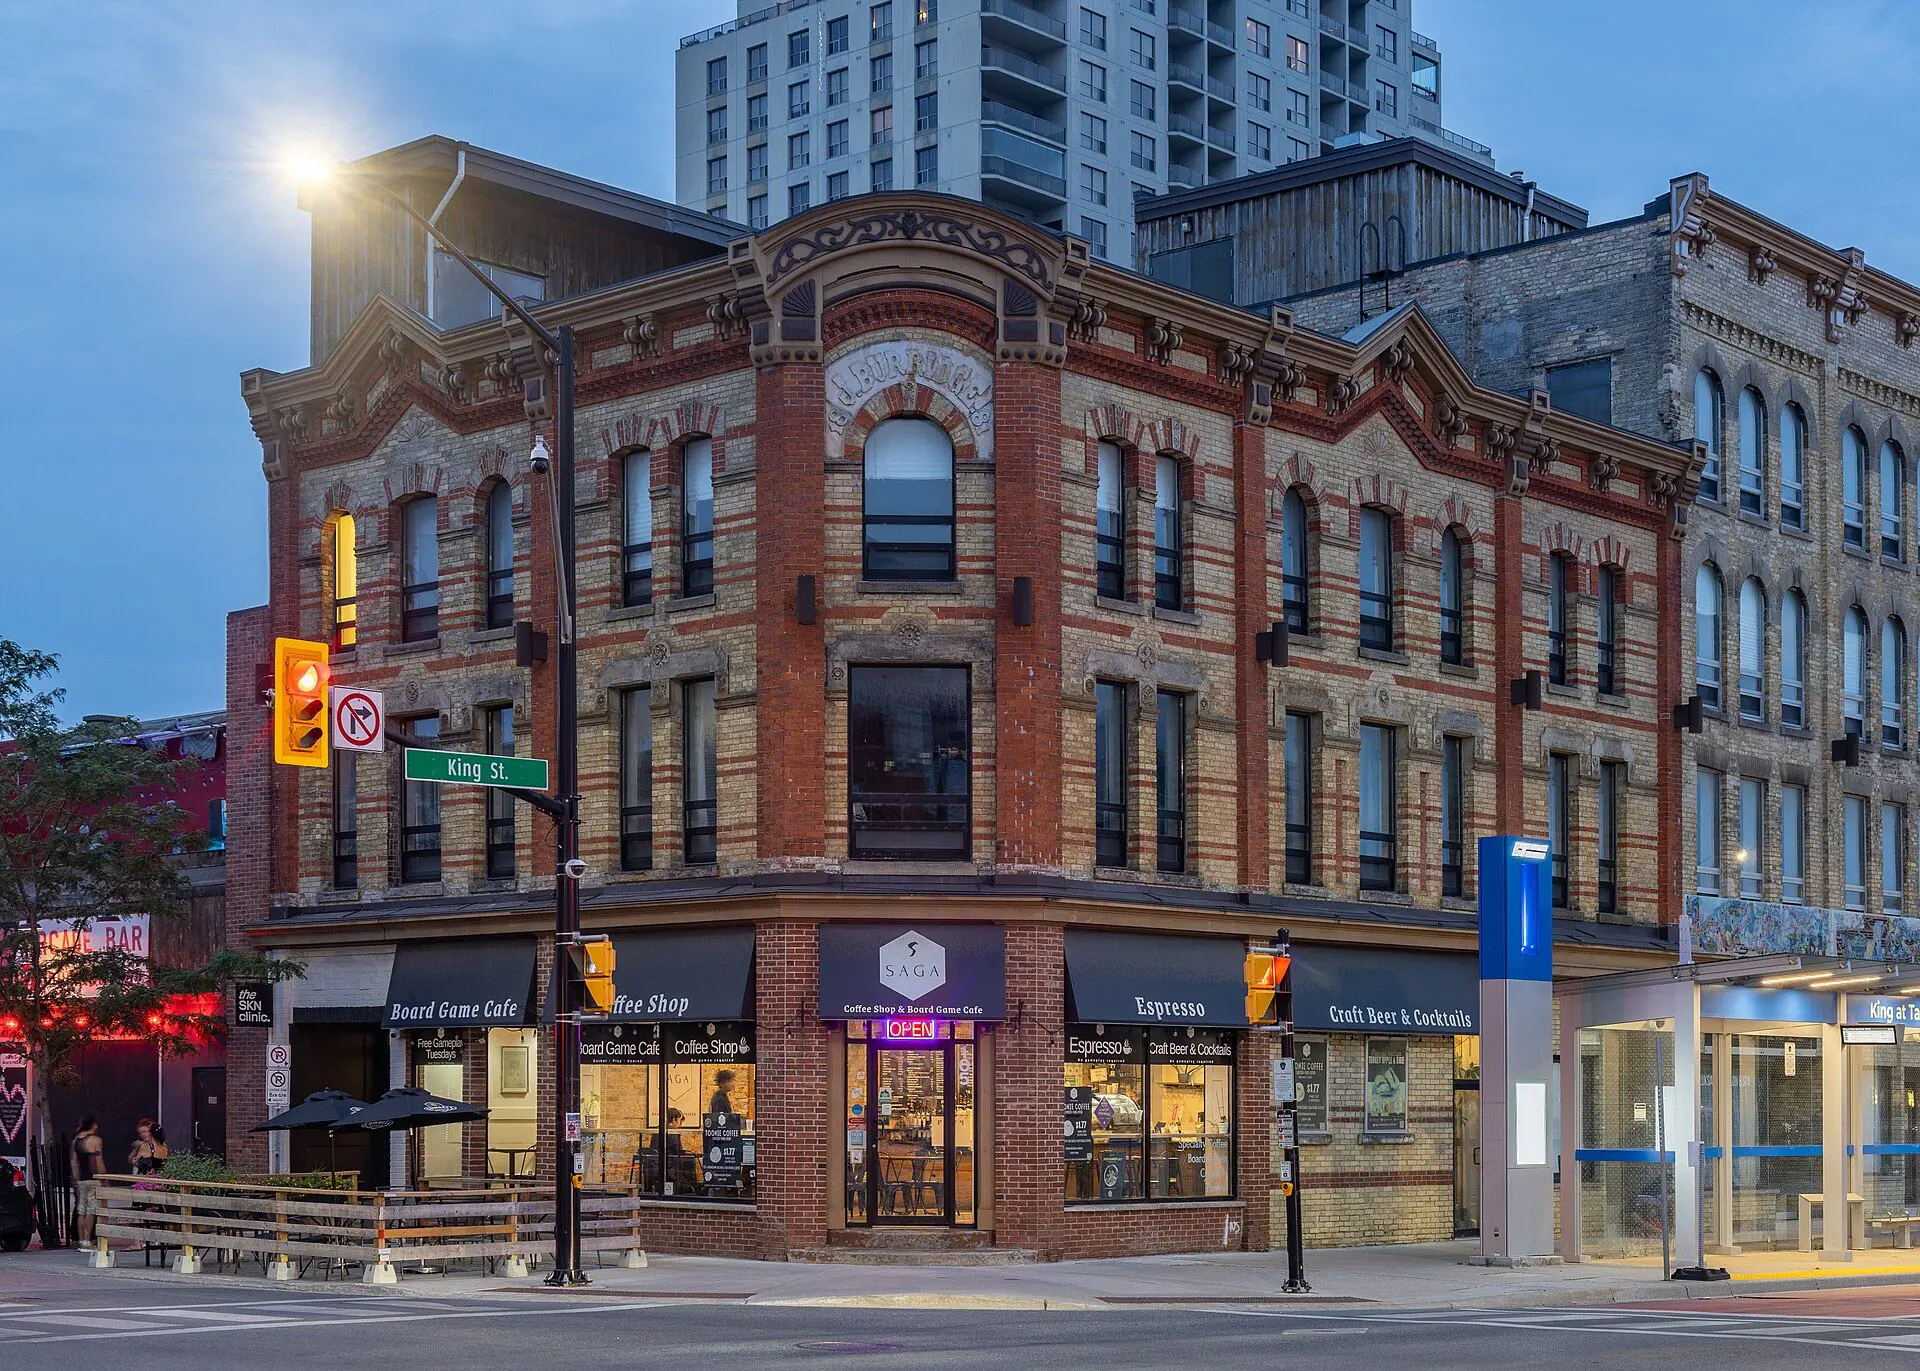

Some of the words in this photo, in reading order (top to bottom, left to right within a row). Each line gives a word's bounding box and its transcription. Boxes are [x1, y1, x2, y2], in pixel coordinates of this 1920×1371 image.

[448, 758, 482, 781] King
[490, 762, 508, 780] St.
[105, 925, 143, 952] BAR
[886, 965, 939, 977] SAGA
[238, 990, 257, 1000] the
[239, 1001, 262, 1011] SKN
[391, 1001, 436, 1020] Board
[438, 1001, 480, 1019] Game
[484, 999, 518, 1017] Cafe
[647, 993, 689, 1016] Shop
[844, 1004, 871, 1013] Coffee
[874, 1005, 896, 1014] Shop
[898, 1005, 905, 1013] &
[907, 1006, 933, 1014] Board
[936, 1006, 961, 1014] Game
[963, 1006, 983, 1014] Cafe
[1135, 997, 1205, 1020] Espresso
[1871, 1000, 1894, 1023] King
[1896, 1005, 1906, 1020] at
[239, 1012, 271, 1022] clinic.
[1330, 1005, 1365, 1023] Craft
[1366, 1007, 1397, 1024] Beer
[1401, 1008, 1411, 1025] &
[1413, 1009, 1472, 1027] Cocktails
[890, 1021, 932, 1037] OPEN
[417, 1038, 432, 1048] Free
[605, 1040, 641, 1055] Game
[674, 1040, 708, 1055] Coffee
[710, 1040, 738, 1059] Shop
[1069, 1037, 1122, 1058] Espresso
[1150, 1042, 1169, 1055] Craft
[1170, 1043, 1189, 1055] Beer
[1190, 1044, 1197, 1055] &
[1197, 1043, 1232, 1056] Cocktails
[426, 1049, 456, 1061] Tuesdays
